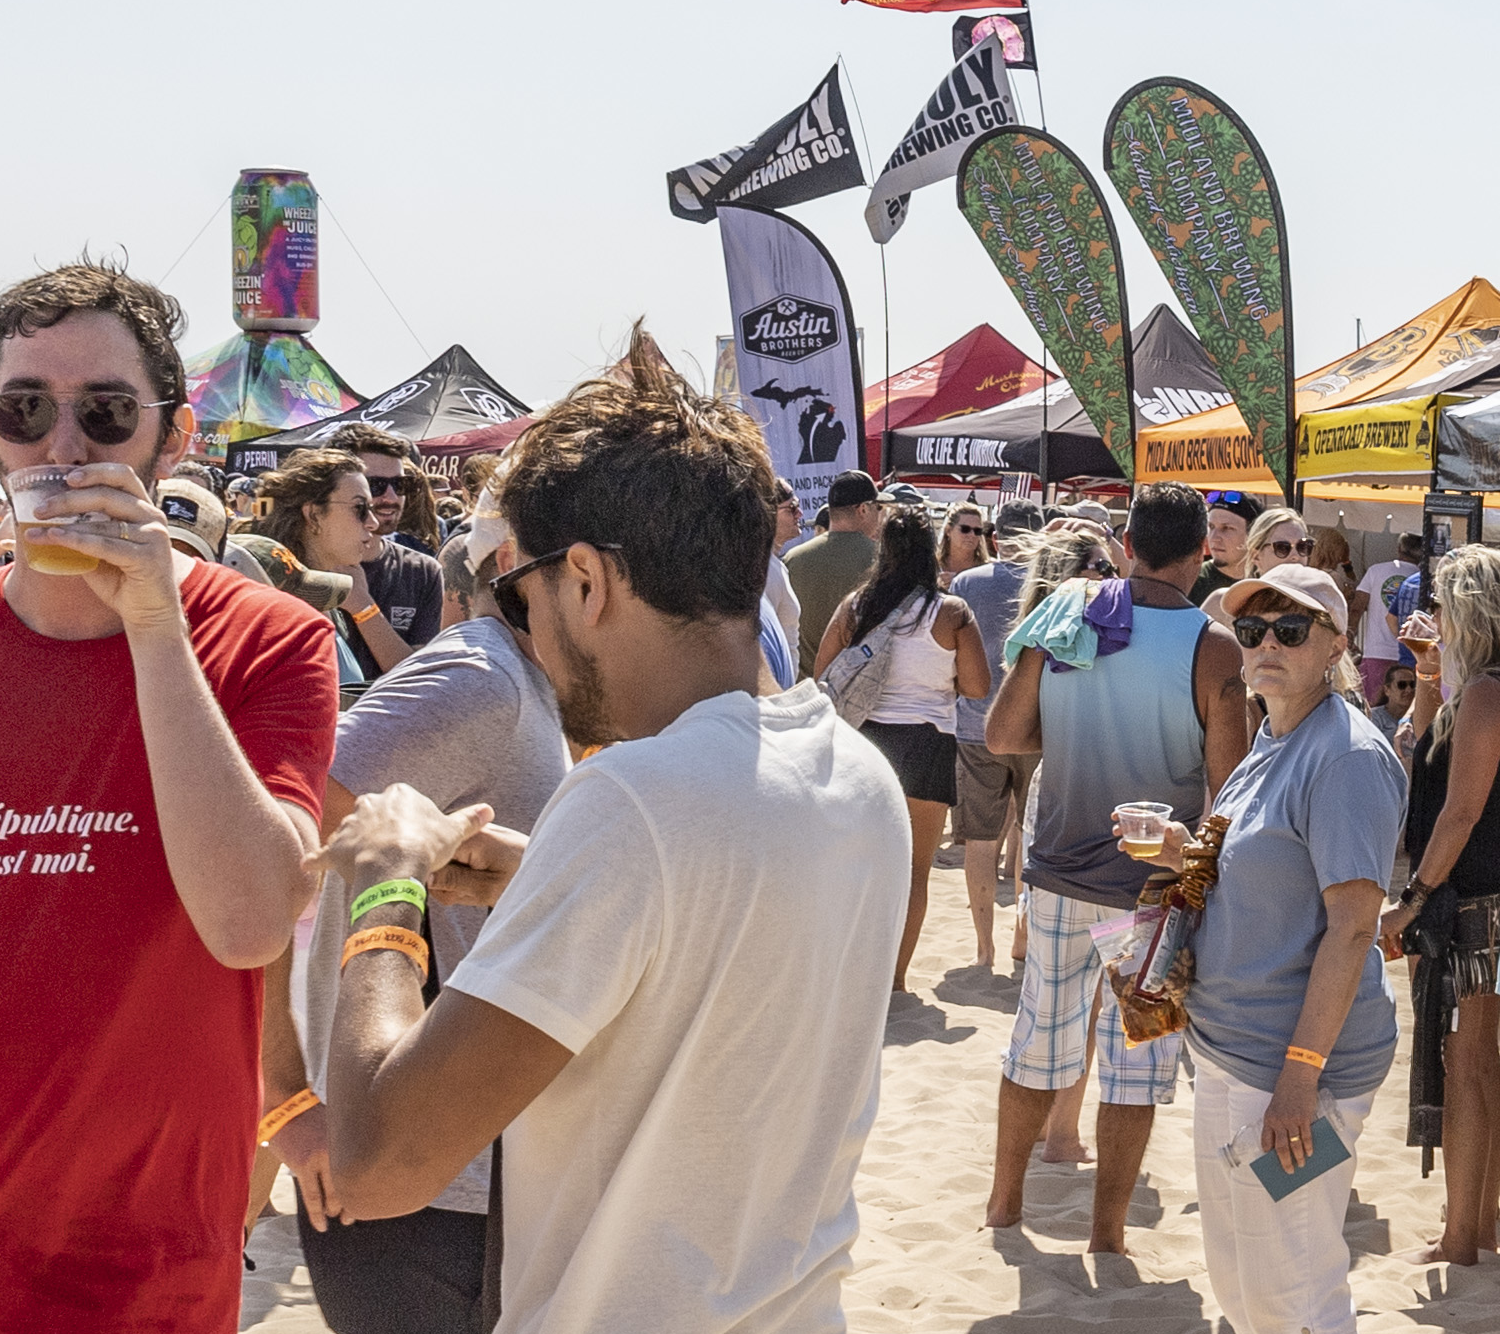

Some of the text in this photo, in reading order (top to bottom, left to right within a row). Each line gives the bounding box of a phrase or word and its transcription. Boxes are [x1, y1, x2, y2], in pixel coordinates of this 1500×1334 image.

[926, 47, 1001, 122] ULY
[975, 100, 1014, 131] CO.
[811, 133, 850, 165] CO.
[1165, 159, 1223, 274] COMPANY
[1171, 96, 1270, 321] MIDLAND BREWING
[1012, 197, 1067, 294] COMPANY
[1013, 140, 1109, 333] MIDLAND BREWING
[1156, 217, 1198, 315] Michigan
[235, 291, 262, 305] UICE
[1007, 246, 1048, 332] Michigan
[748, 311, 832, 341] Austin
[760, 337, 823, 352] BROTHERS
[916, 437, 935, 465] LIVE
[956, 437, 969, 465] BE
[1145, 434, 1262, 473] MIDLAND BREWING COMP
[1314, 420, 1411, 455] OPENROAD BREWERY
[243, 451, 278, 471] PERRIN
[795, 477, 812, 491] AND
[802, 498, 811, 511] IN
[31, 843, 95, 874] moi.
